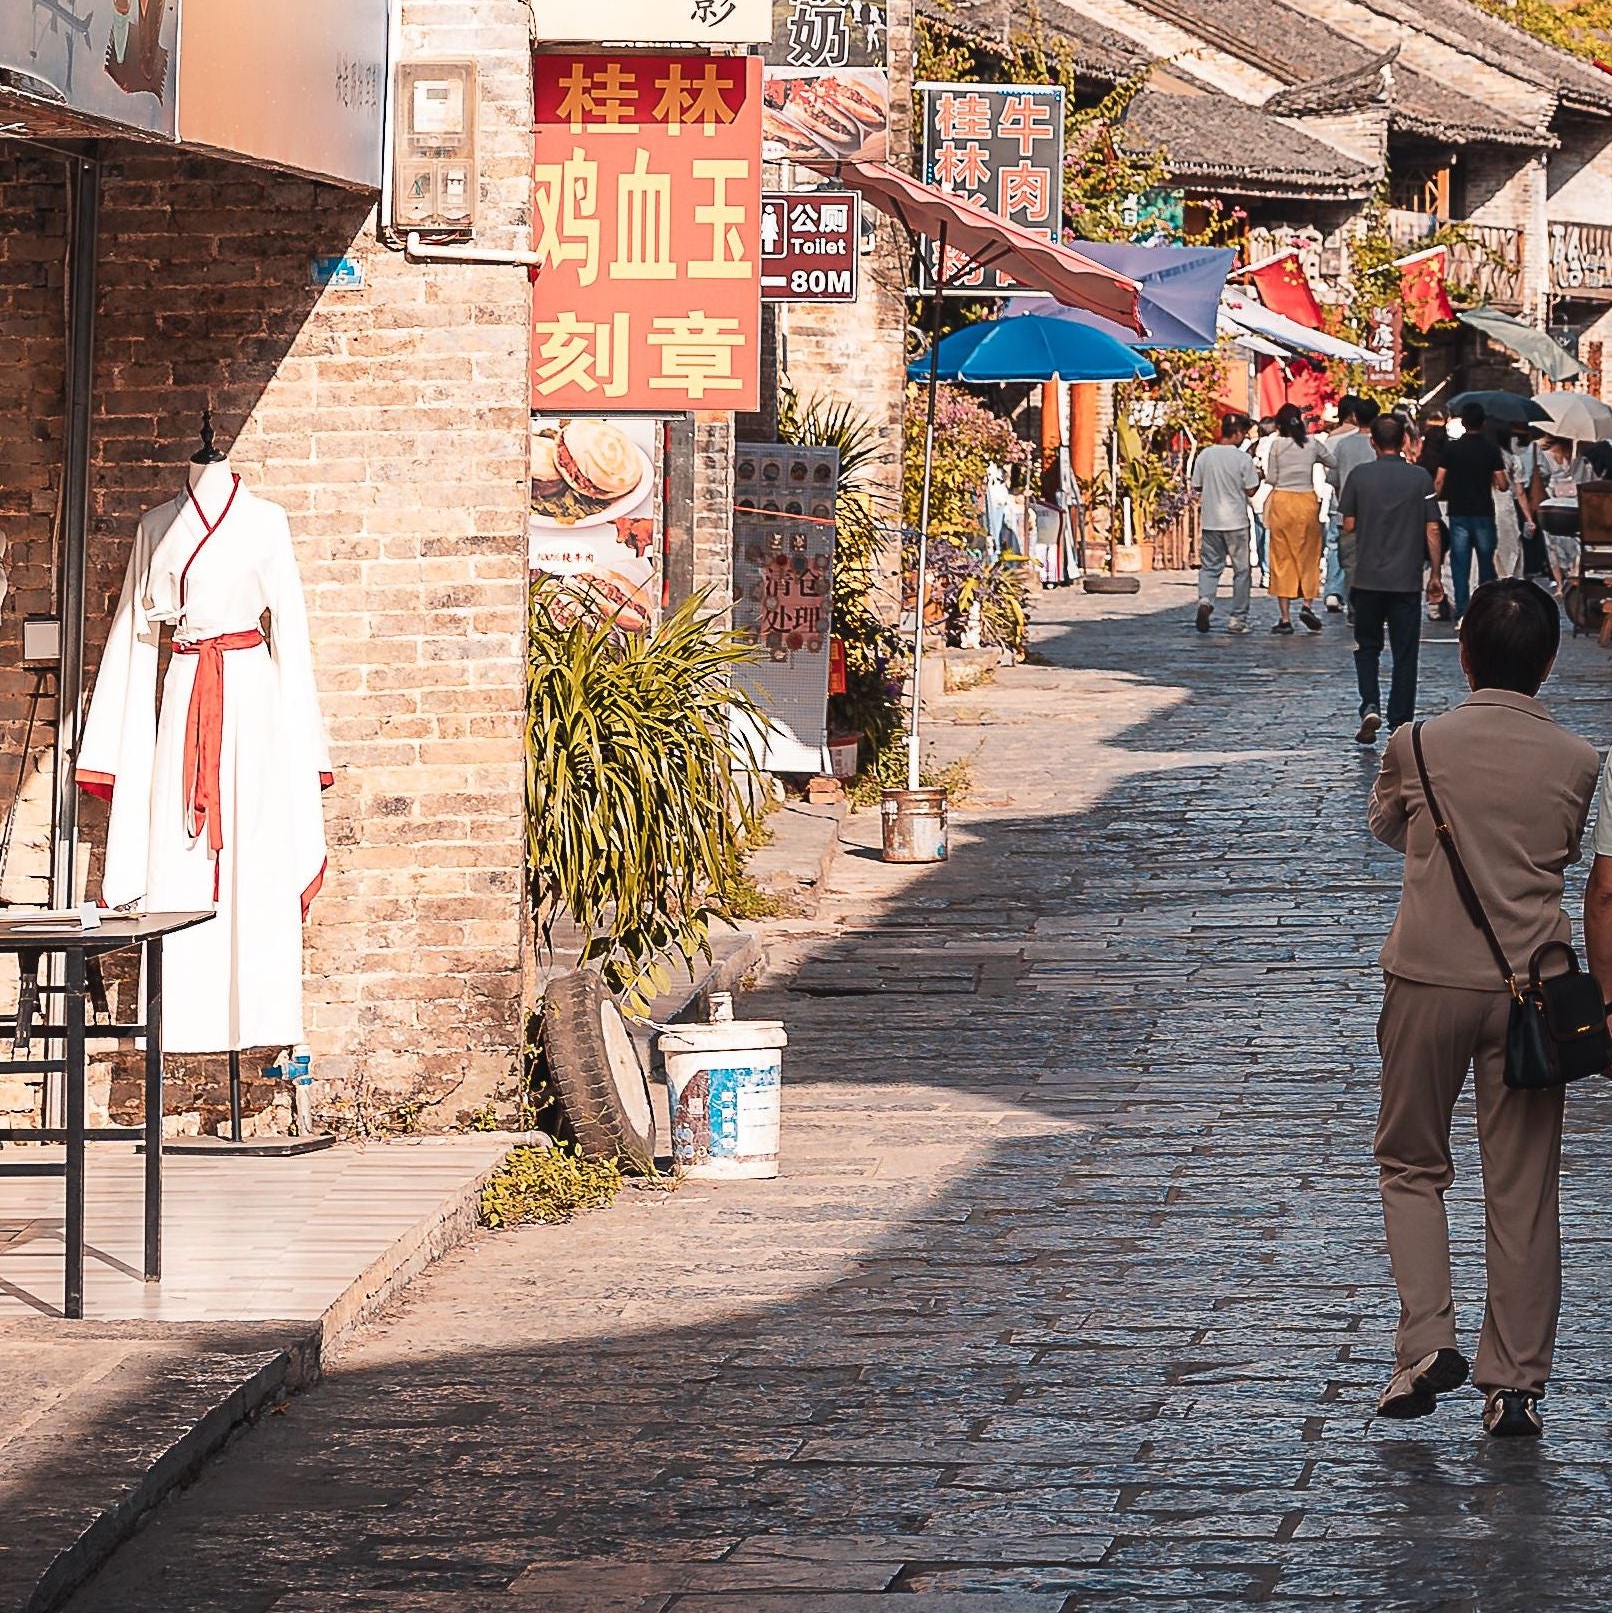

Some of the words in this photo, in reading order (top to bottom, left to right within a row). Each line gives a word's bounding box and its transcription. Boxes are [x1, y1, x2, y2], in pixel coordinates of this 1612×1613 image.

[557, 62, 737, 138] 桂林
[935, 92, 992, 286] 桂林粉
[533, 144, 753, 289] 鸡血玉
[789, 203, 849, 233] 公厕
[790, 237, 847, 255] Toilet
[790, 269, 851, 293] 80M
[533, 310, 746, 400] 刻章
[765, 568, 821, 598] 清仓
[763, 604, 821, 634] 处理
